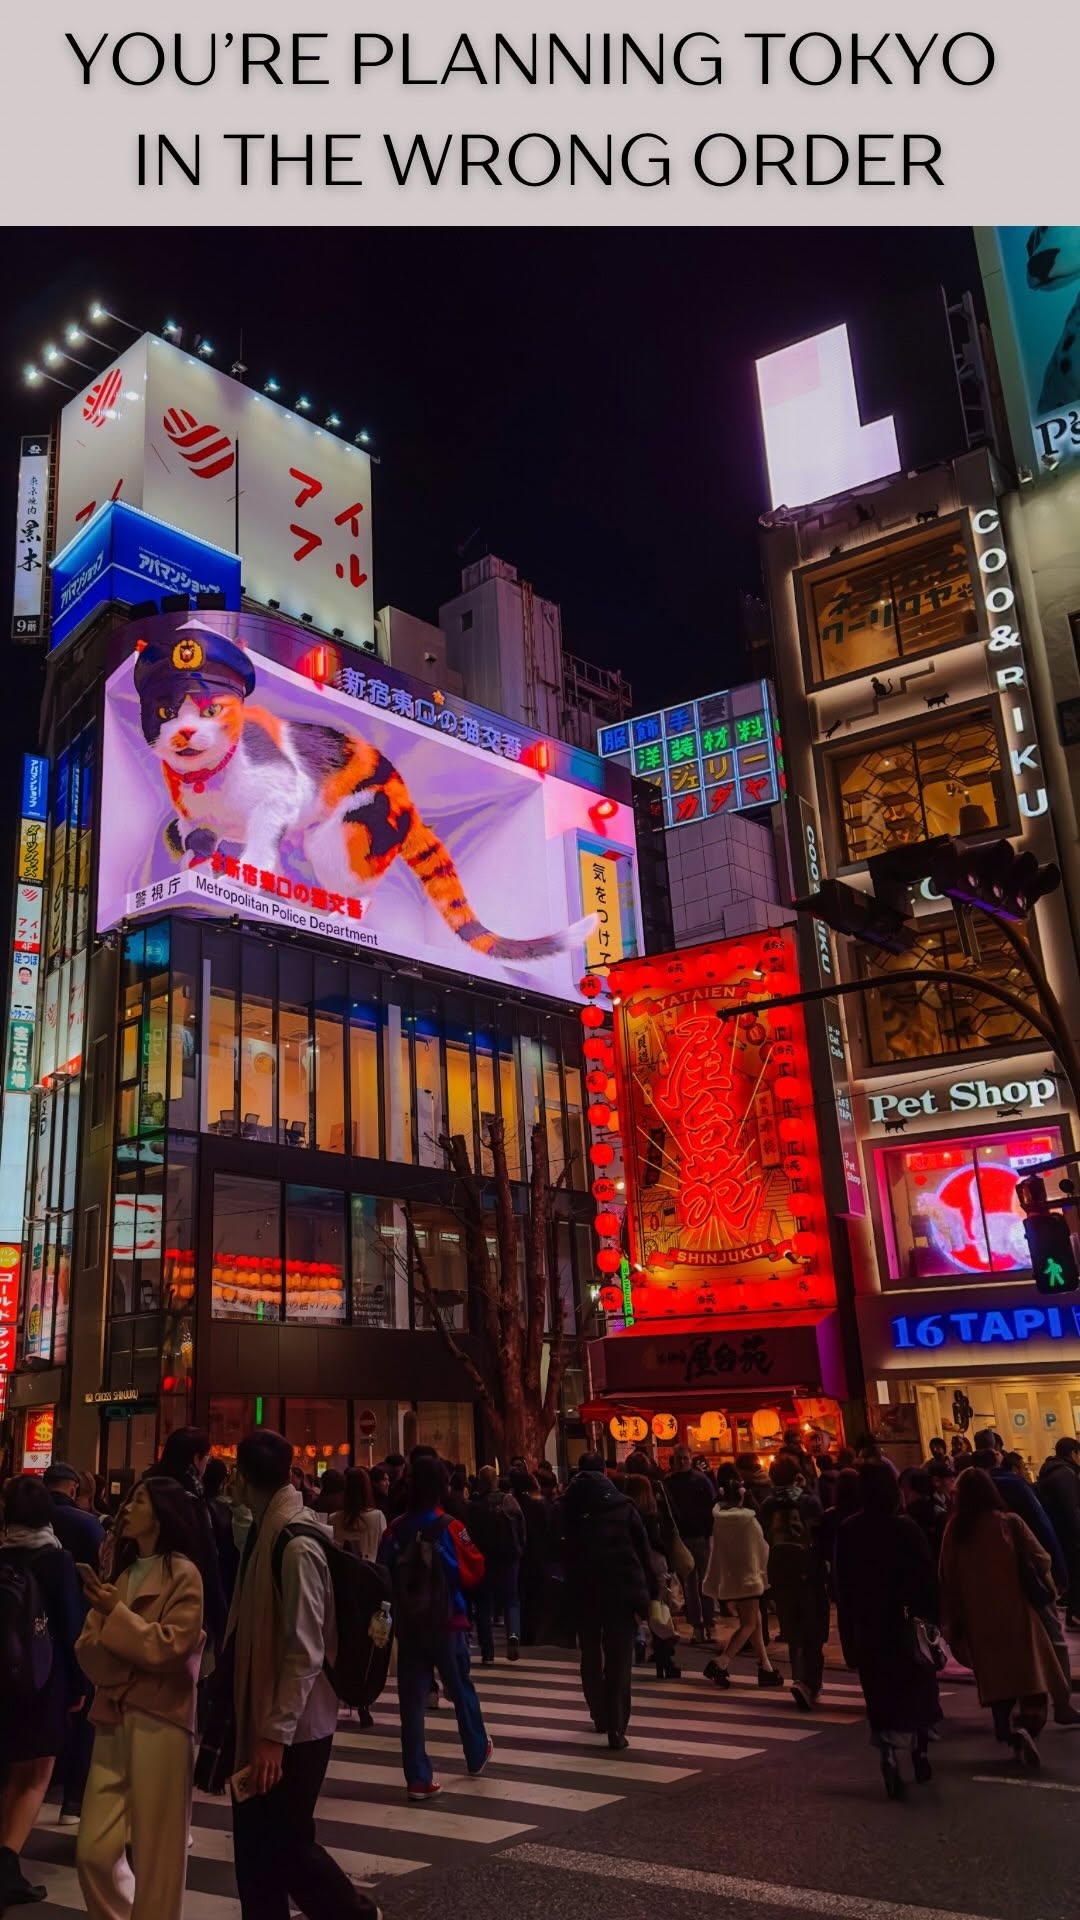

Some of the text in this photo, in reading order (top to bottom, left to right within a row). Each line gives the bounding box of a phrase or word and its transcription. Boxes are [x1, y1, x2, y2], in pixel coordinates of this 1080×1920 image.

[340, 667, 522, 761] 新宿東口の猫交番
[638, 716, 764, 770] 洋装材料
[134, 876, 181, 909] 警視庁
[195, 875, 378, 947] Metropolitan Police Department
[656, 985, 736, 1011] YATAIEN
[870, 1076, 1056, 1123] Pet Shop
[676, 1243, 763, 1265] SHINJUKU
[892, 1307, 1063, 1347] 16 TAPI
